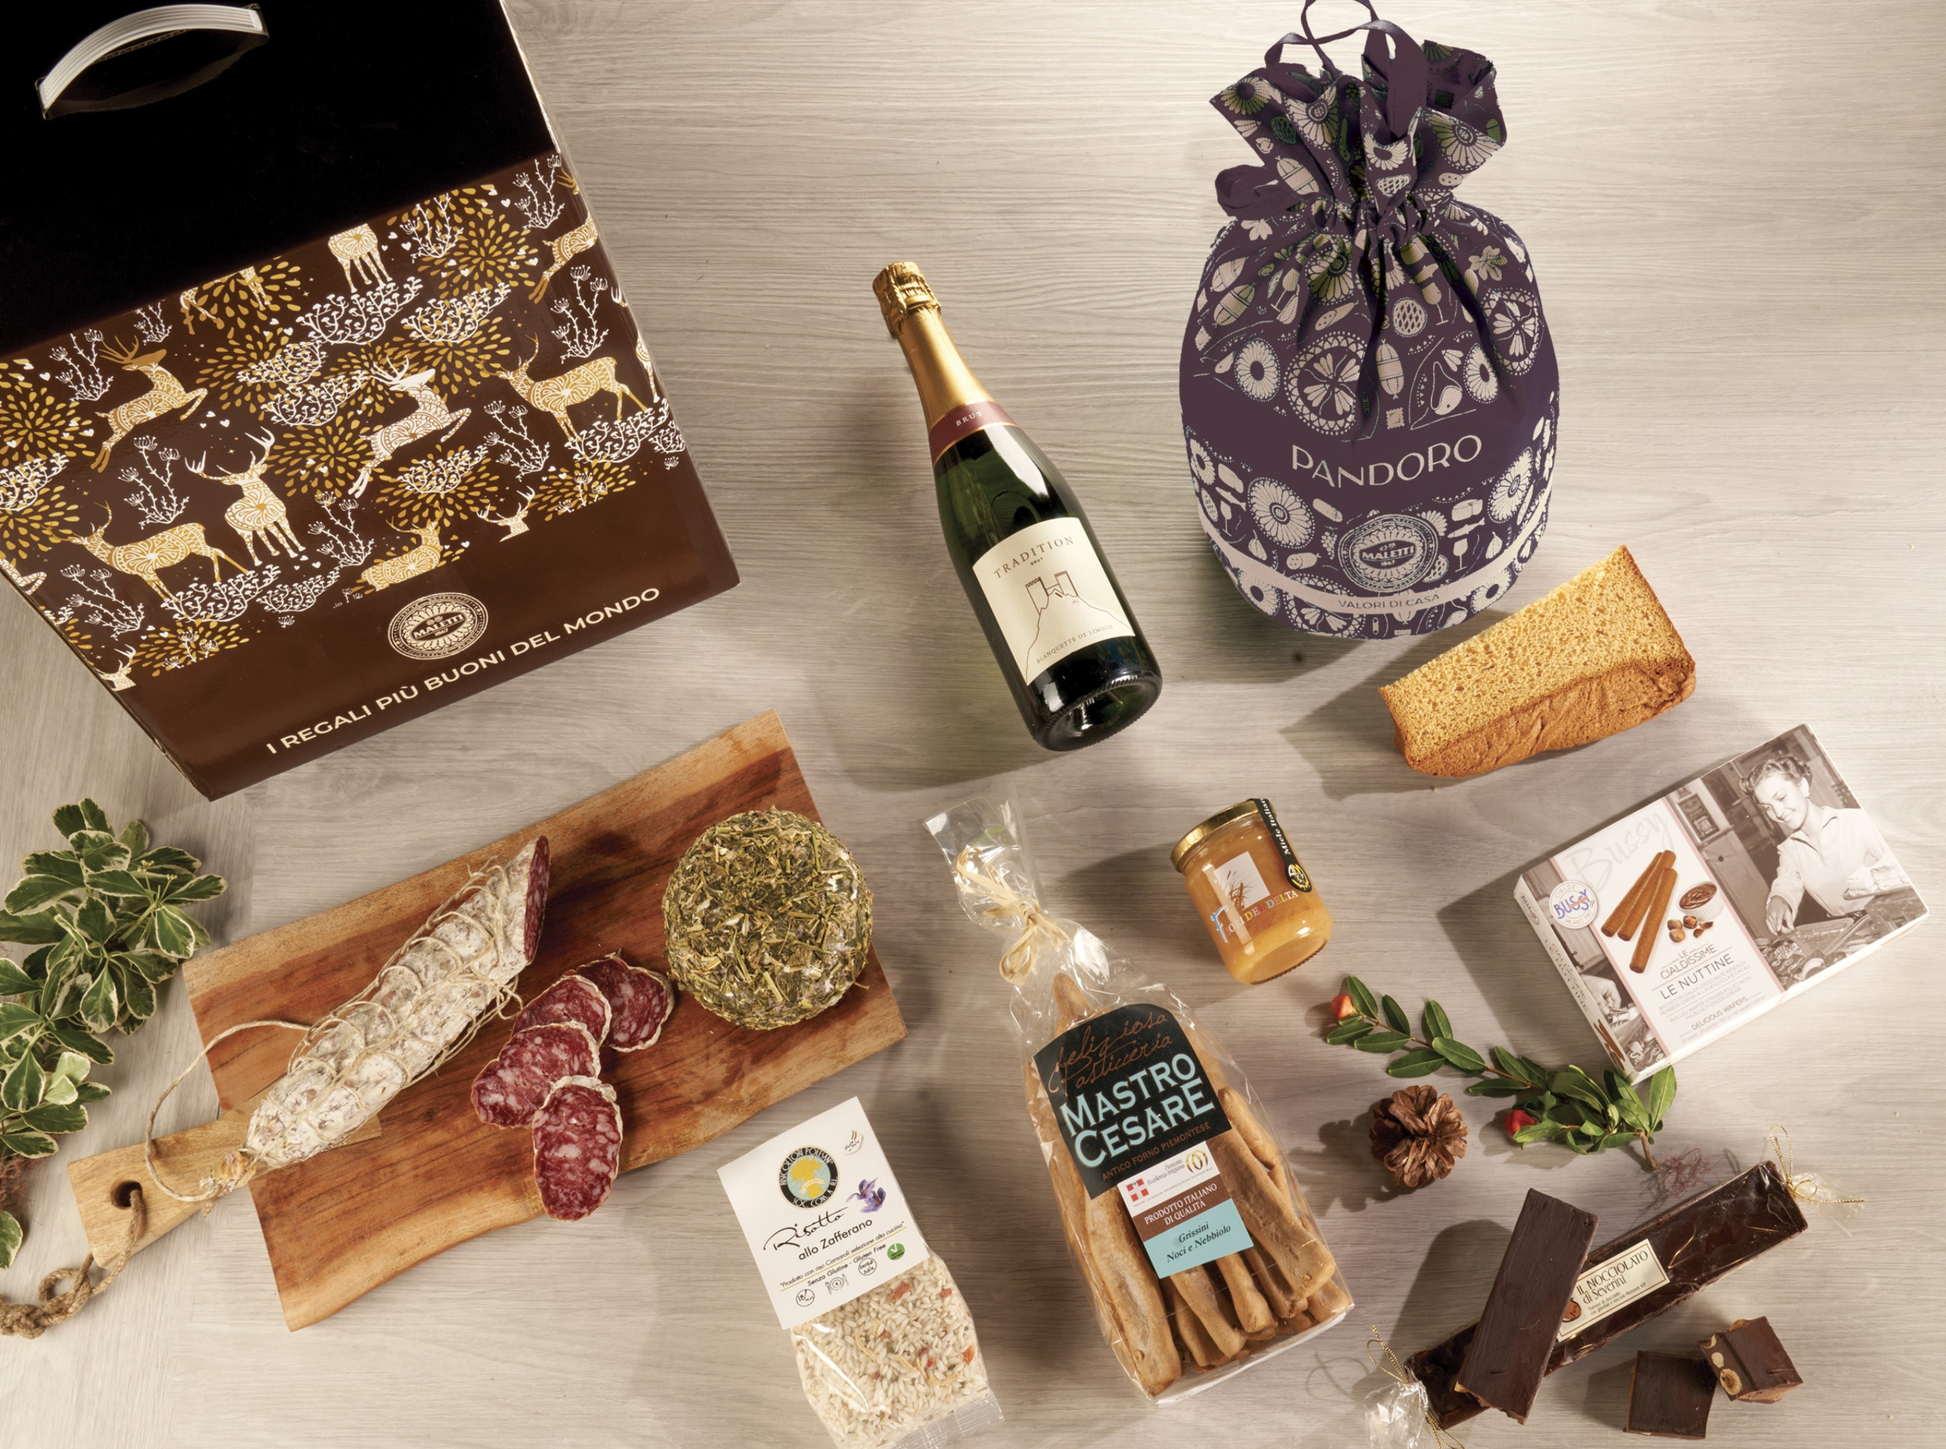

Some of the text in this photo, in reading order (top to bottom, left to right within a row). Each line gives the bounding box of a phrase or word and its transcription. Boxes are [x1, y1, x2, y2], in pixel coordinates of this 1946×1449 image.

[955, 411, 983, 427] BRUT
[1291, 434, 1482, 489] PANDORO
[993, 536, 1074, 579] TRADITION
[1030, 557, 1044, 566] BRUT
[1361, 545, 1415, 560] MALETTI
[1338, 600, 1386, 610] VALORI
[1405, 594, 1440, 608] CASA
[413, 613, 465, 639] MALETTI
[1036, 624, 1114, 664] BLANQUETTE DE LIMOUX
[266, 587, 661, 754] I REGALI PIÙ BUONI DEL MONDO
[1275, 828, 1291, 855] Miele
[1210, 890, 1300, 944] FIORI DEL DELTA
[1553, 889, 1590, 920] BUSSY
[1660, 943, 1718, 980] CIALDISSIME
[1678, 949, 1690, 959] LE
[1660, 953, 1735, 1000] LE NUTTINE
[1691, 996, 1748, 1030] DELICIOUS WAFERS
[1059, 1053, 1196, 1138] MASTRO
[1074, 1077, 1216, 1168] CESARE
[1102, 1121, 1211, 1181] ANTICO FORNO PIEMONTESE
[1143, 1182, 1218, 1225] PRODOTTO ITALIANO
[1164, 1199, 1206, 1226] DI QUALITÀ
[763, 1206, 848, 1251] Risotto
[798, 1219, 873, 1261] allo Zafferano
[1166, 1225, 1231, 1263] Noci e Nebbiolo
[1178, 1221, 1210, 1243] Grissini
[806, 1273, 825, 1287] Senza
[826, 1262, 848, 1277] Glutine
[852, 1249, 872, 1263] Gluten
[872, 1242, 886, 1253] Free
[815, 1263, 824, 1271] riso
[850, 1237, 874, 1253] selezione
[1576, 1250, 1649, 1296] IL NOCCIOLATO
[1582, 1274, 1627, 1305] di Severini
